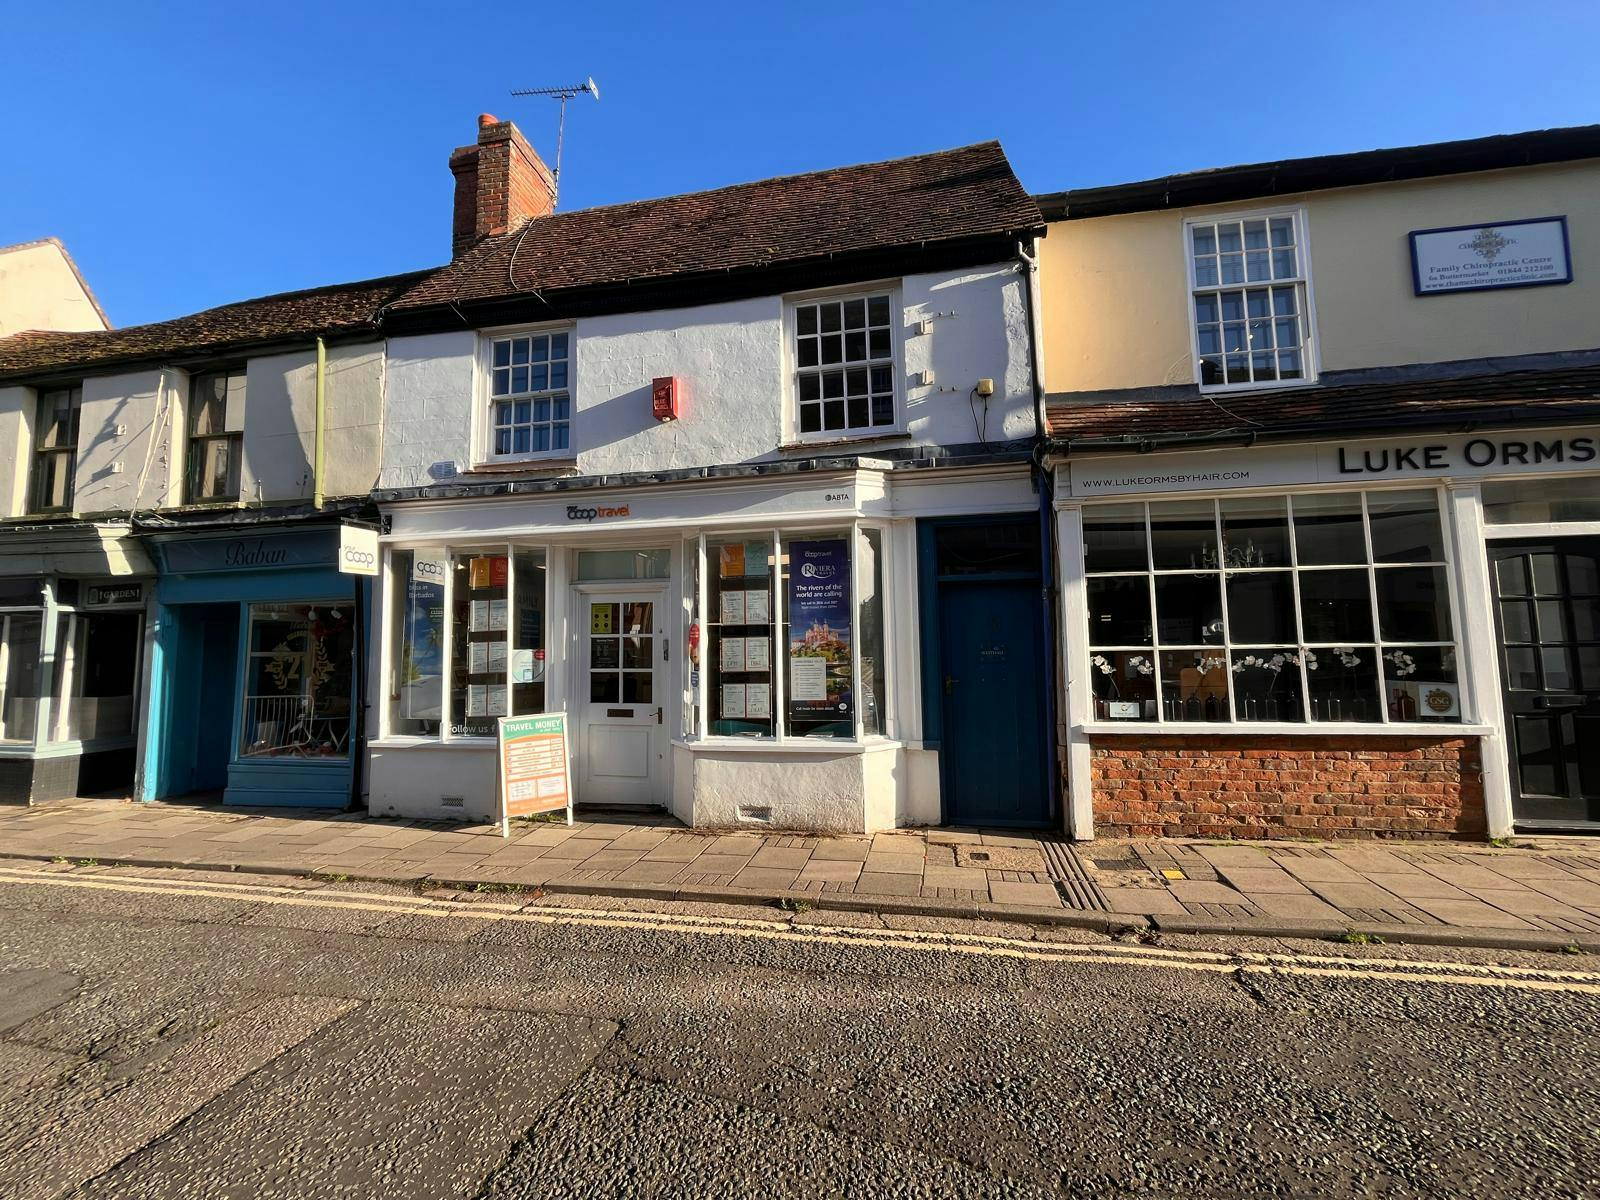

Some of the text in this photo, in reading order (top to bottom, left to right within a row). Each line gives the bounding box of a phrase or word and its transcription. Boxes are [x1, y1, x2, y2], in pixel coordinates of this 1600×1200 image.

[1430, 256, 1552, 273] Family Chiropractic Centre
[1338, 438, 1600, 474] LUKE ORMS
[1082, 470, 1250, 488] WWW.LUKEORMSBYHAIR.COM
[597, 504, 630, 518] travel
[225, 540, 287, 565] Baban
[345, 550, 374, 568] coop
[104, 589, 136, 599] GARDEN
[823, 590, 842, 598] calling
[452, 724, 476, 733] ollow
[506, 719, 560, 732] TRAVEL MONEY
